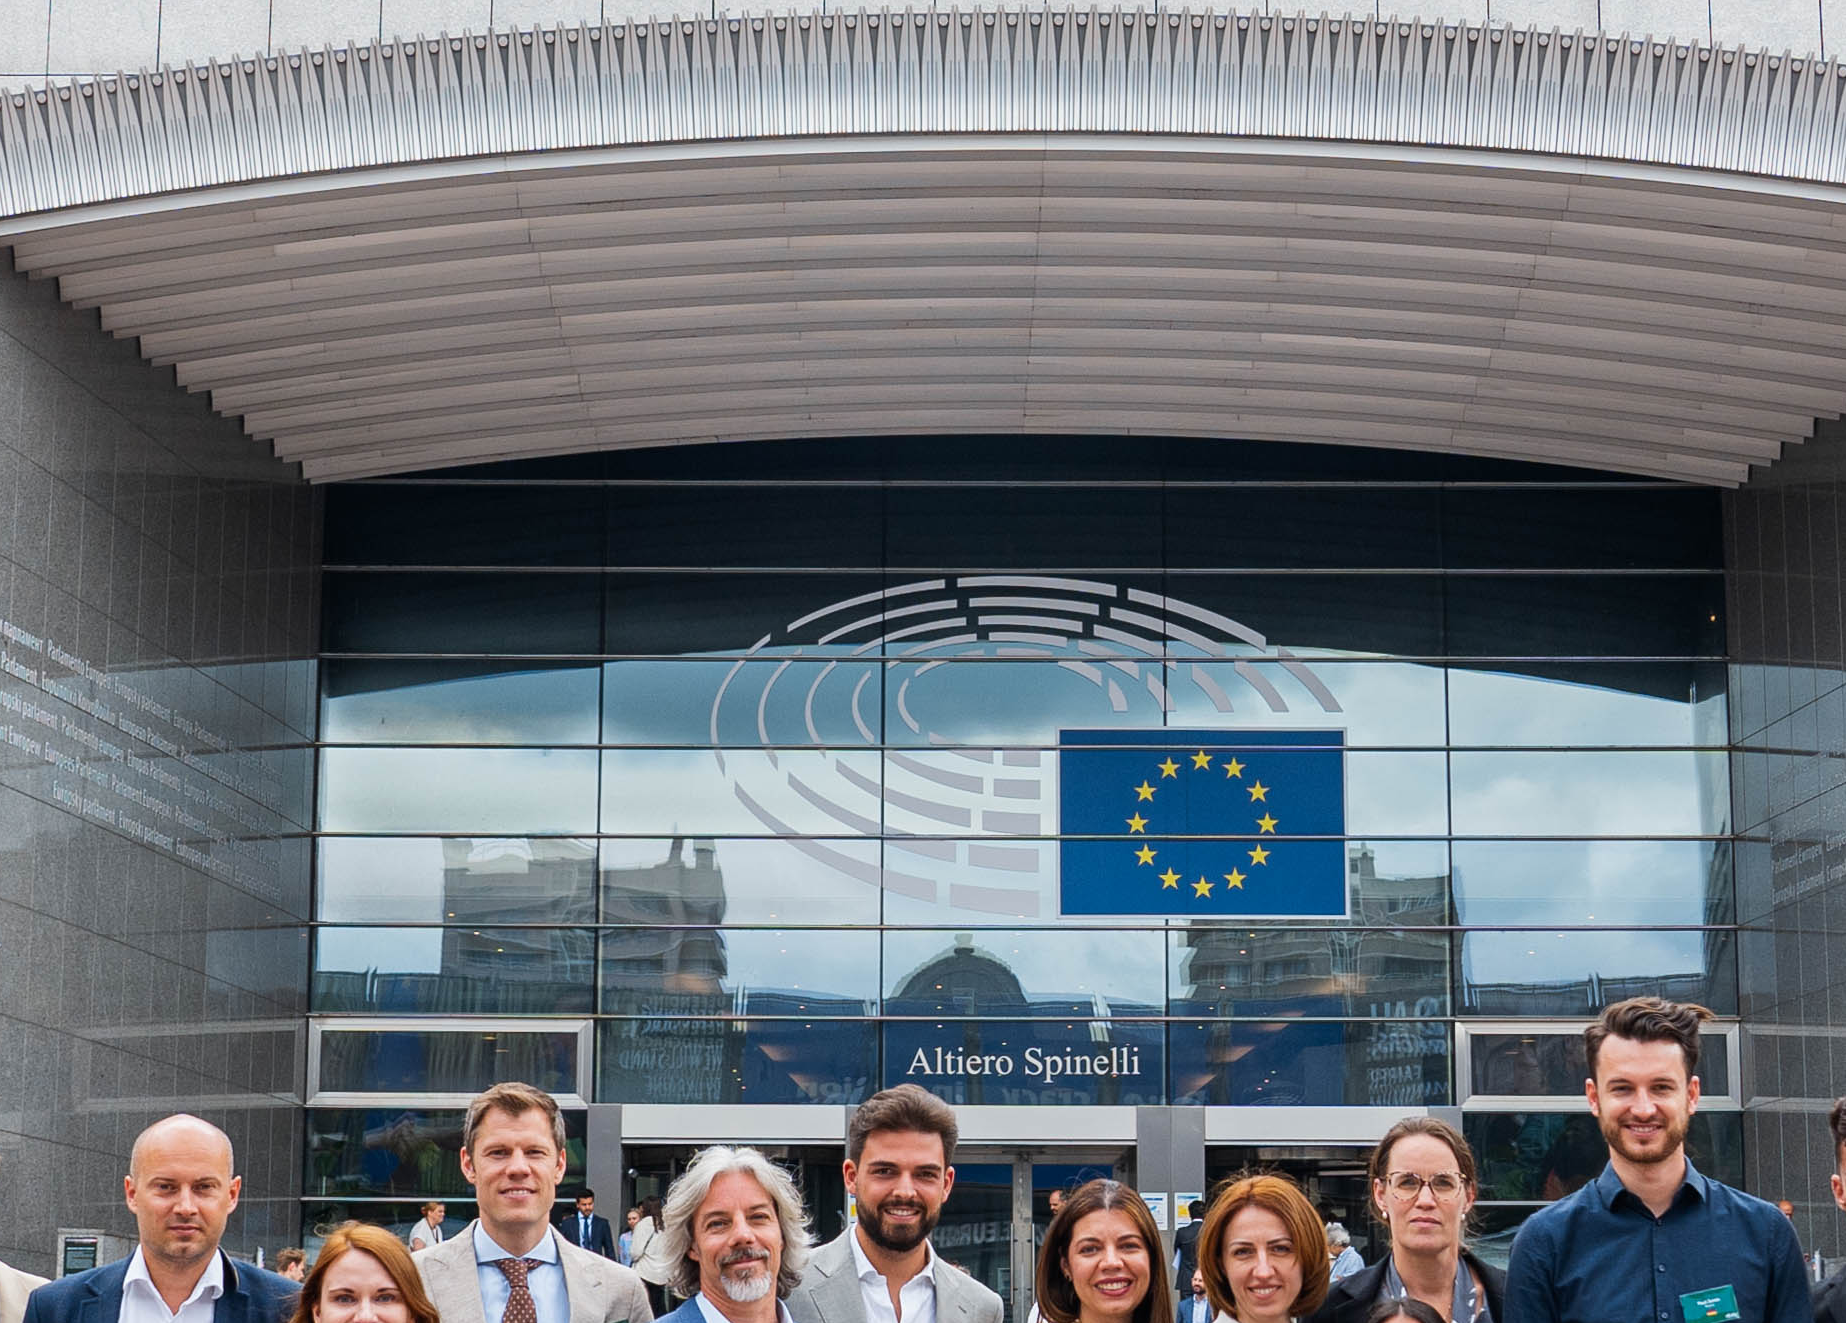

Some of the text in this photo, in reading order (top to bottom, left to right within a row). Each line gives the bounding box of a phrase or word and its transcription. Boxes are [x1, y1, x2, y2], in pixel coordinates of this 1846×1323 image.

[1, 651, 38, 687] Parlament
[906, 1047, 1140, 1083] Altiero Spinelli
